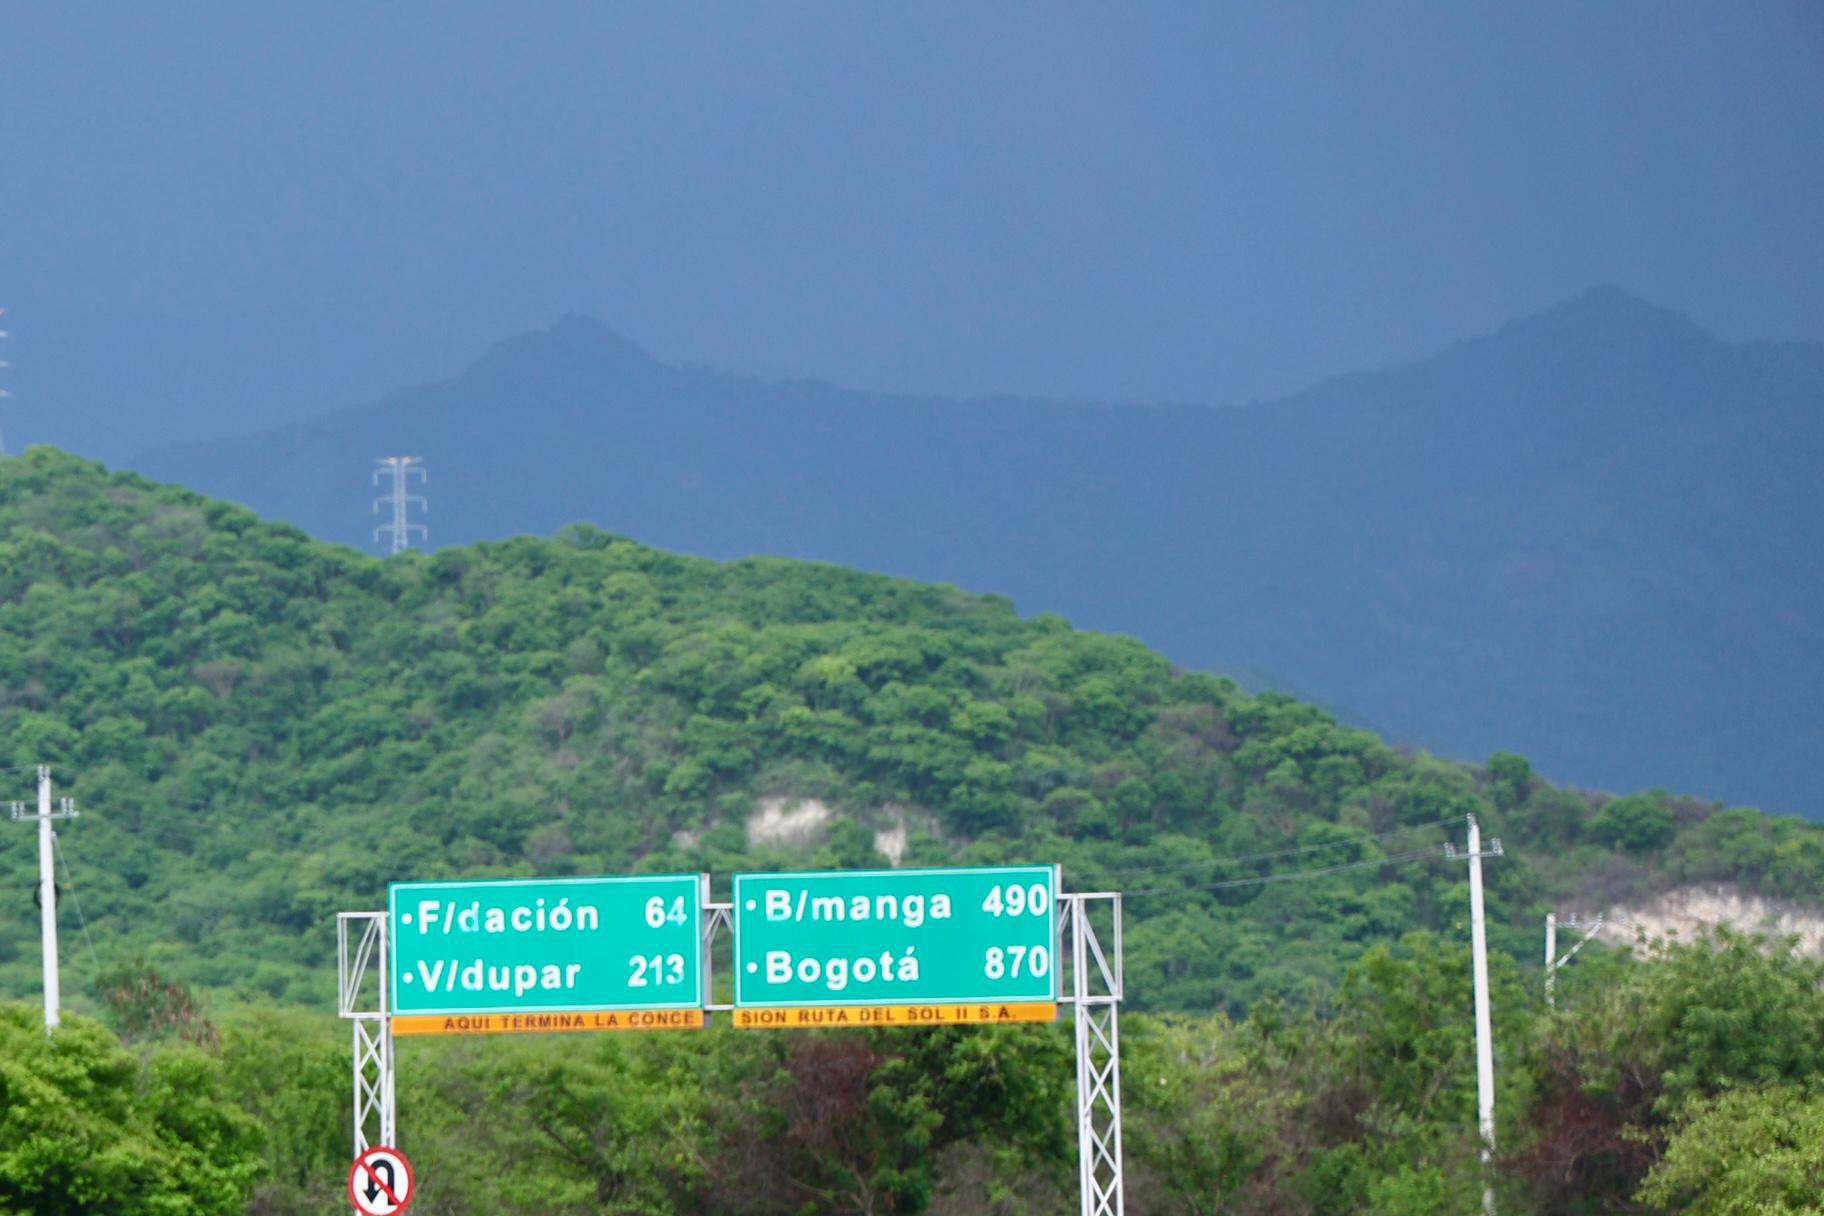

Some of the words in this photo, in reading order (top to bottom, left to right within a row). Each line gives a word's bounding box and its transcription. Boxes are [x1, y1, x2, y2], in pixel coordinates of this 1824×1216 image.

[418, 898, 599, 934] F/dación
[644, 896, 688, 928] 64
[765, 889, 952, 928] B/manga
[981, 884, 1048, 917] 490
[417, 959, 582, 997] V/dupar
[627, 954, 685, 987] 213
[765, 946, 920, 991] Bogotá
[984, 945, 1049, 980] 870
[444, 1015, 490, 1030] AQUI
[501, 1013, 585, 1029] TERMINA
[595, 1013, 618, 1026] LA
[628, 1010, 695, 1025] CONCE
[741, 1009, 787, 1025] SION
[798, 1008, 849, 1023] RUTA
[859, 1008, 896, 1021] DEL
[907, 1007, 945, 1021] SOL
[956, 1007, 967, 1020] II
[979, 1006, 1017, 1020] S.A.
